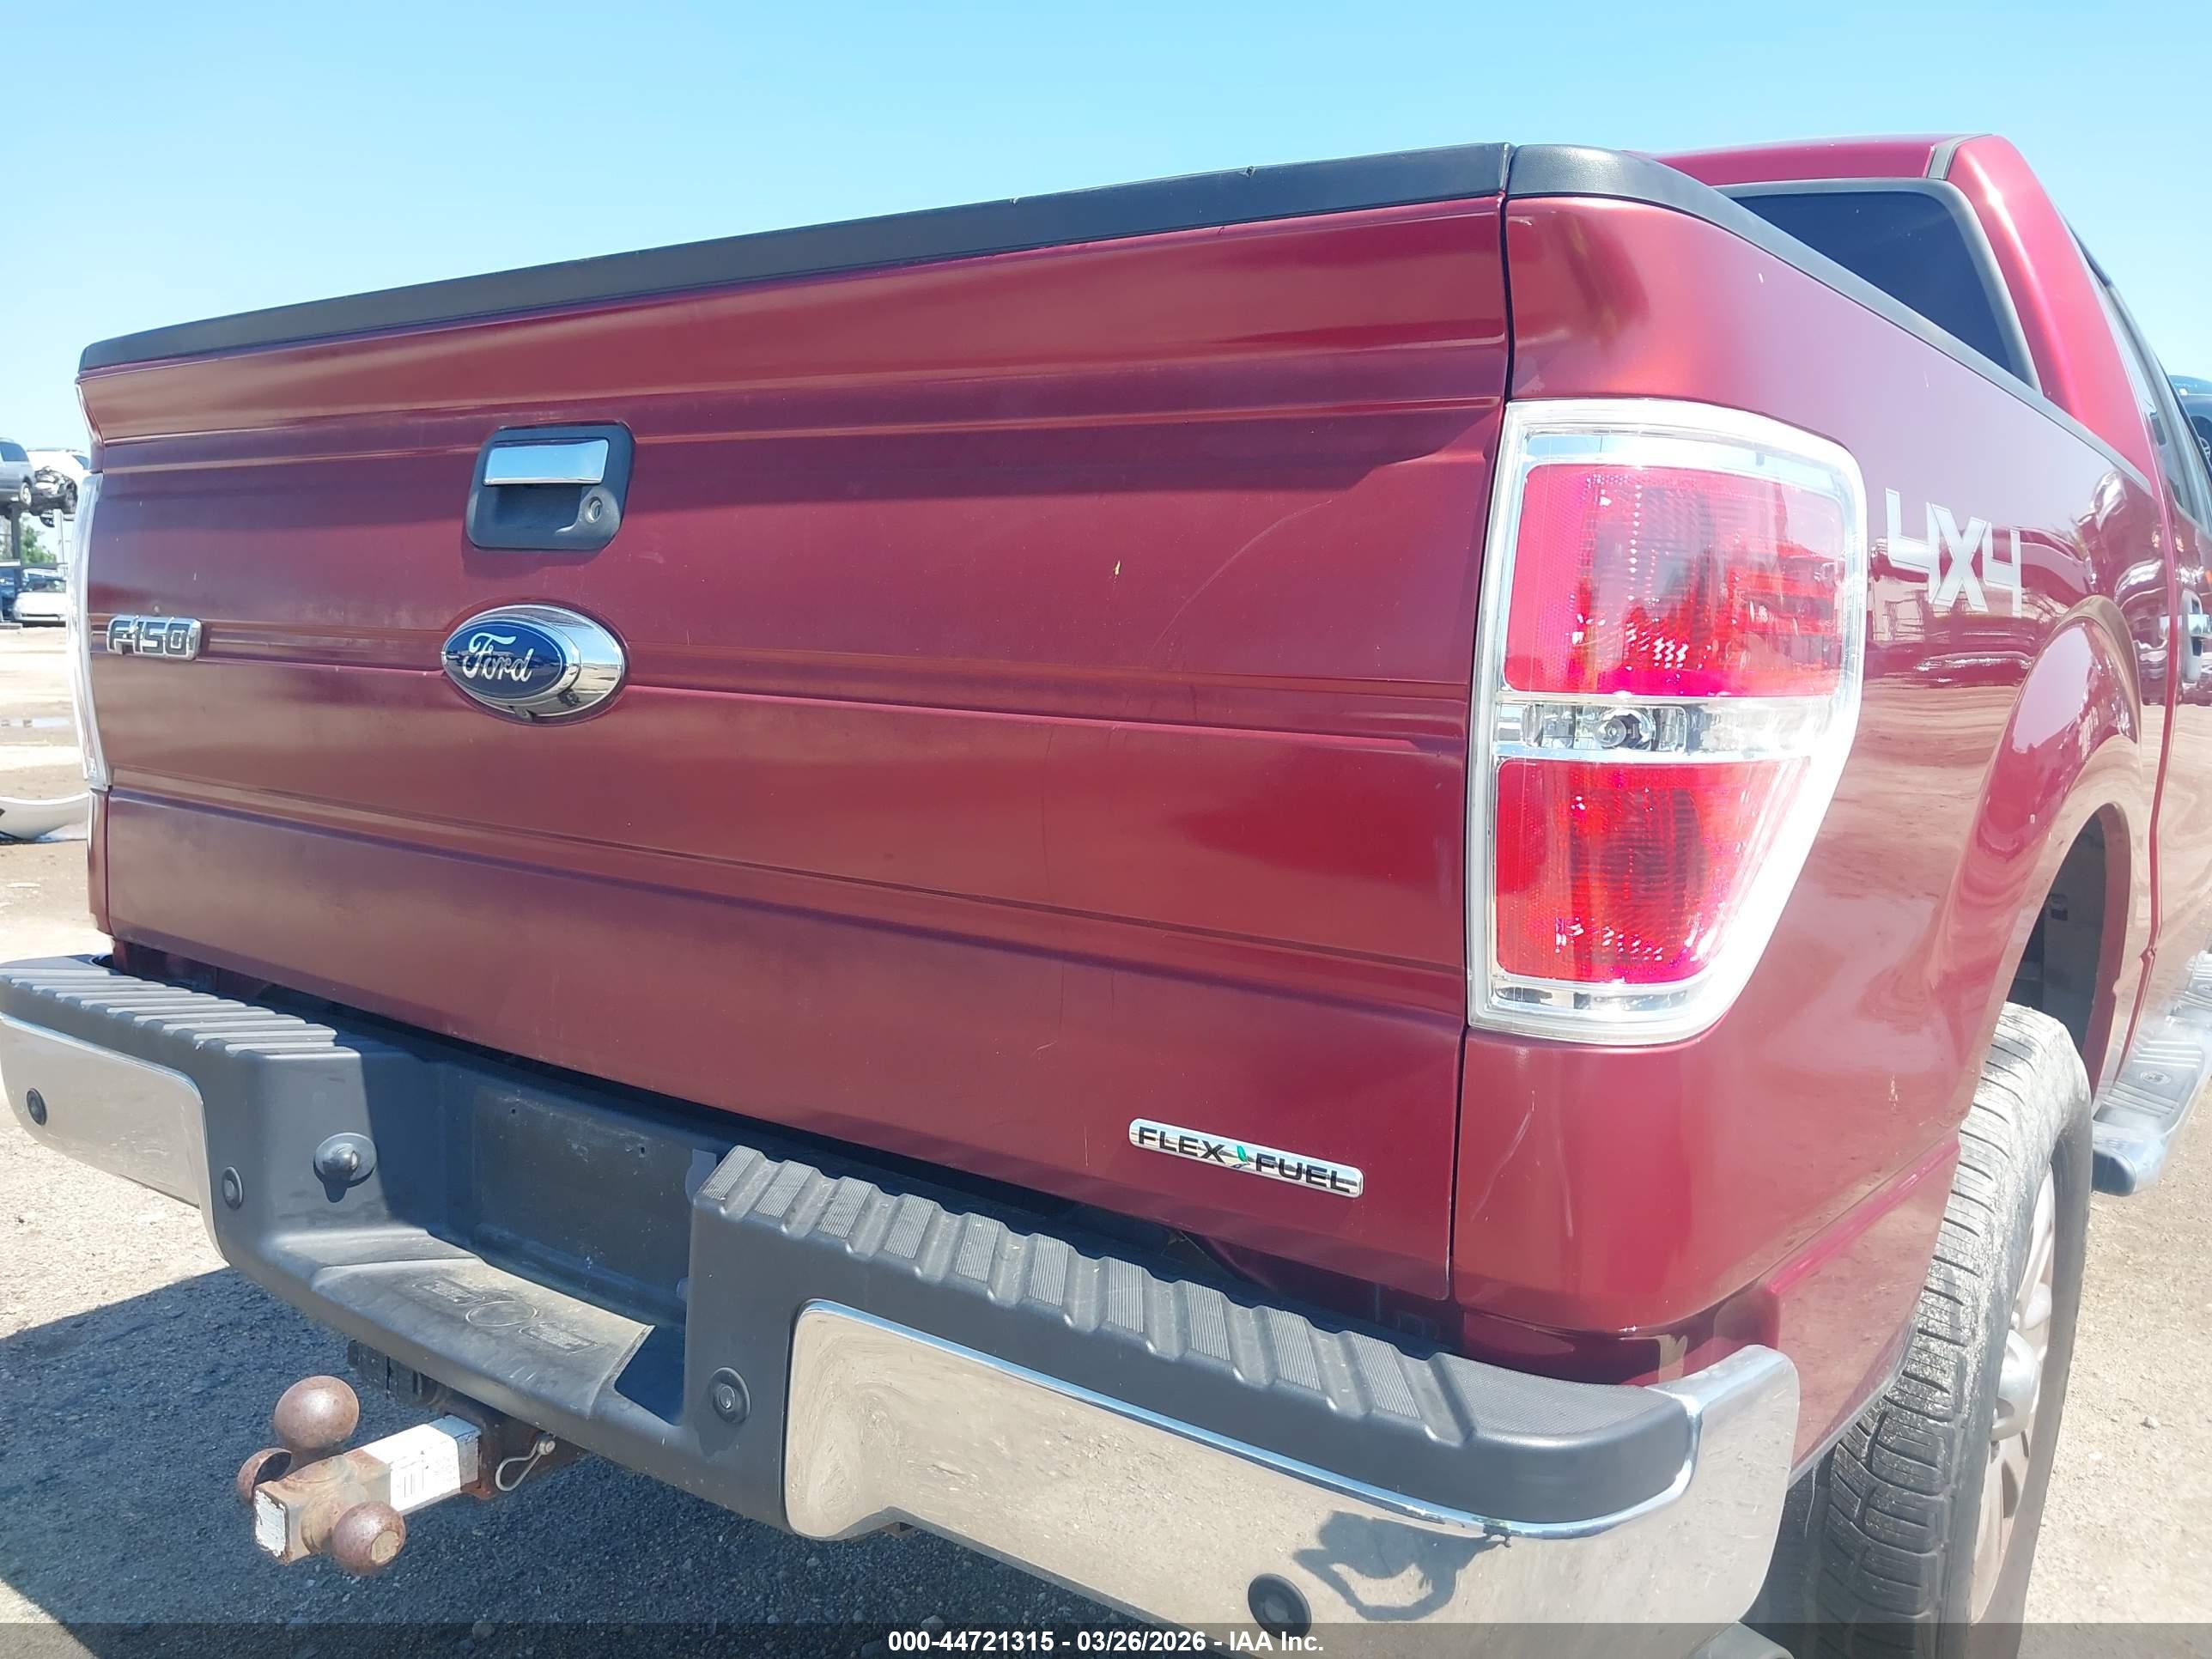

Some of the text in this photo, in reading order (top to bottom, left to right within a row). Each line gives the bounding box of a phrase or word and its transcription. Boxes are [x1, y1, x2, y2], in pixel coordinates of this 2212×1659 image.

[462, 632, 534, 683] Ford
[1138, 1126, 1351, 1194] FLEX FUEL
